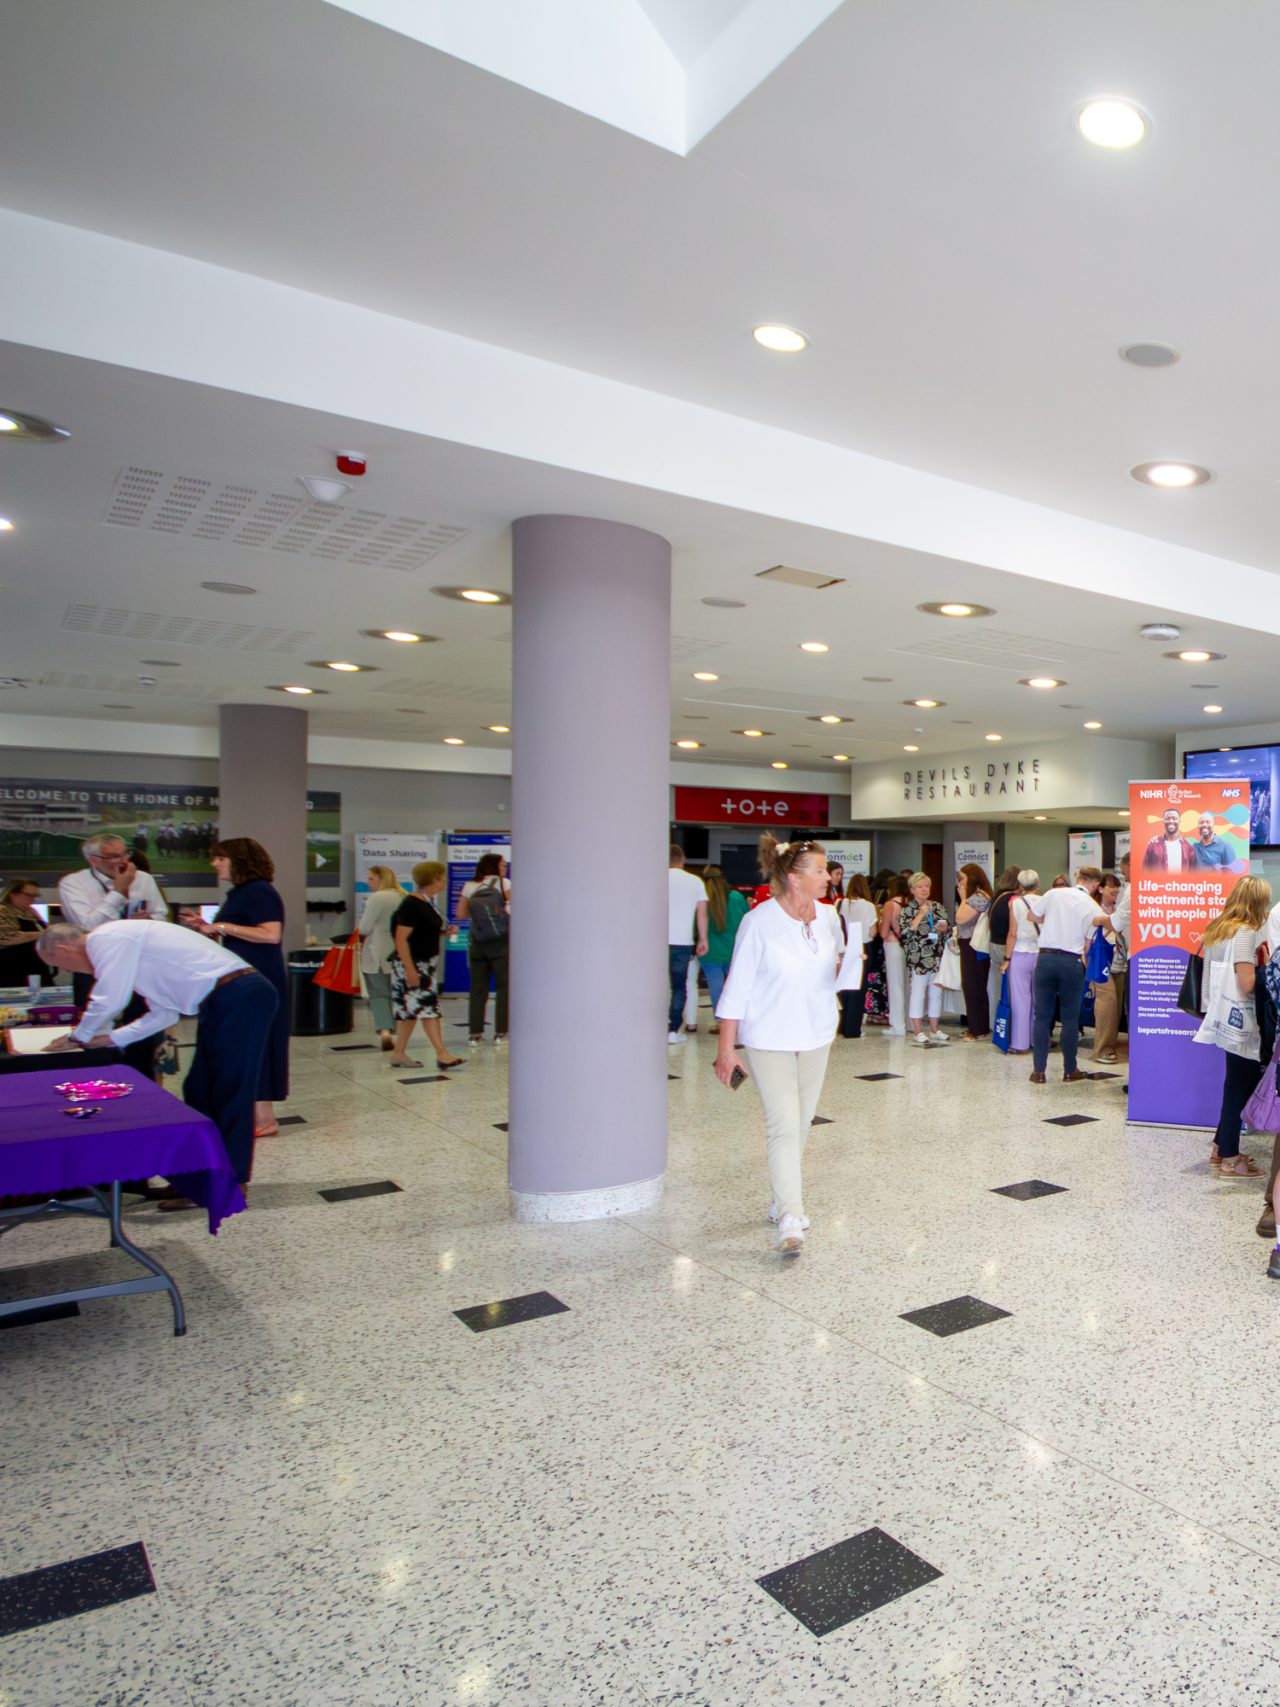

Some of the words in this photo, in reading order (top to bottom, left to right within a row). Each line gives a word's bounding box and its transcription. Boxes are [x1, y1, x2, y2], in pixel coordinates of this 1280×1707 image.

[904, 765, 971, 784] DEVILS
[987, 759, 1040, 777] DYKE
[904, 778, 1040, 800] RESTAURANT
[1140, 789, 1163, 799] NIHR
[1222, 788, 1241, 798] NHS
[70, 790, 90, 802] TO
[97, 791, 128, 803] THE
[134, 793, 178, 805] HOME
[184, 795, 205, 806] OF
[362, 849, 386, 857] Data
[388, 849, 428, 859] Sharing
[826, 853, 863, 862] onnect
[957, 851, 989, 862] Connect
[1138, 881, 1223, 895] Life-changing
[1138, 895, 1206, 905] treatments
[1208, 895, 1227, 906] sta
[1138, 907, 1164, 919] with
[1166, 907, 1207, 921] people
[1209, 908, 1224, 919] lik
[1138, 922, 1181, 941] you
